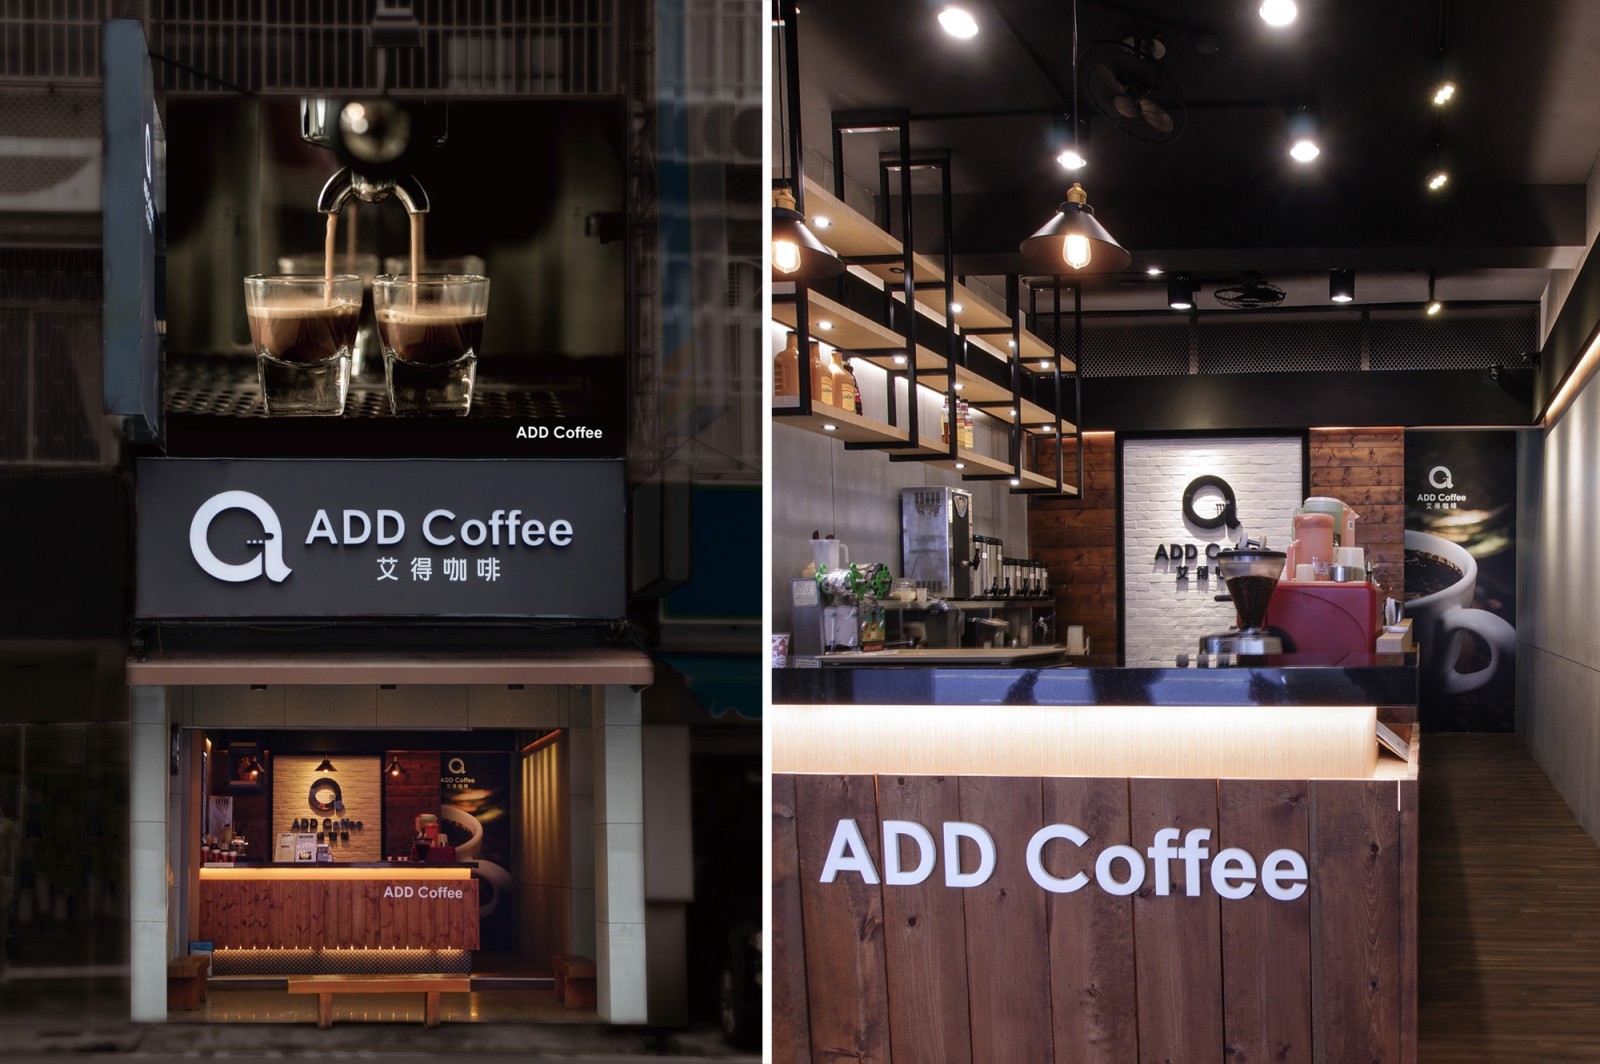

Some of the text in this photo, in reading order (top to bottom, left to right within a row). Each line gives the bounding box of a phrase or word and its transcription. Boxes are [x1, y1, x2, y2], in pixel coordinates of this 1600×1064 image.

[516, 426, 603, 439] ADD Coffee
[1417, 493, 1467, 502] ADD Coffee
[304, 509, 574, 548] ADD Coffee
[1154, 543, 1198, 560] ADD
[376, 557, 501, 582] 艾得咖啡
[291, 818, 318, 831] ADD
[819, 818, 1309, 901] ADD Coffee
[383, 886, 463, 899] ADD Coffee
